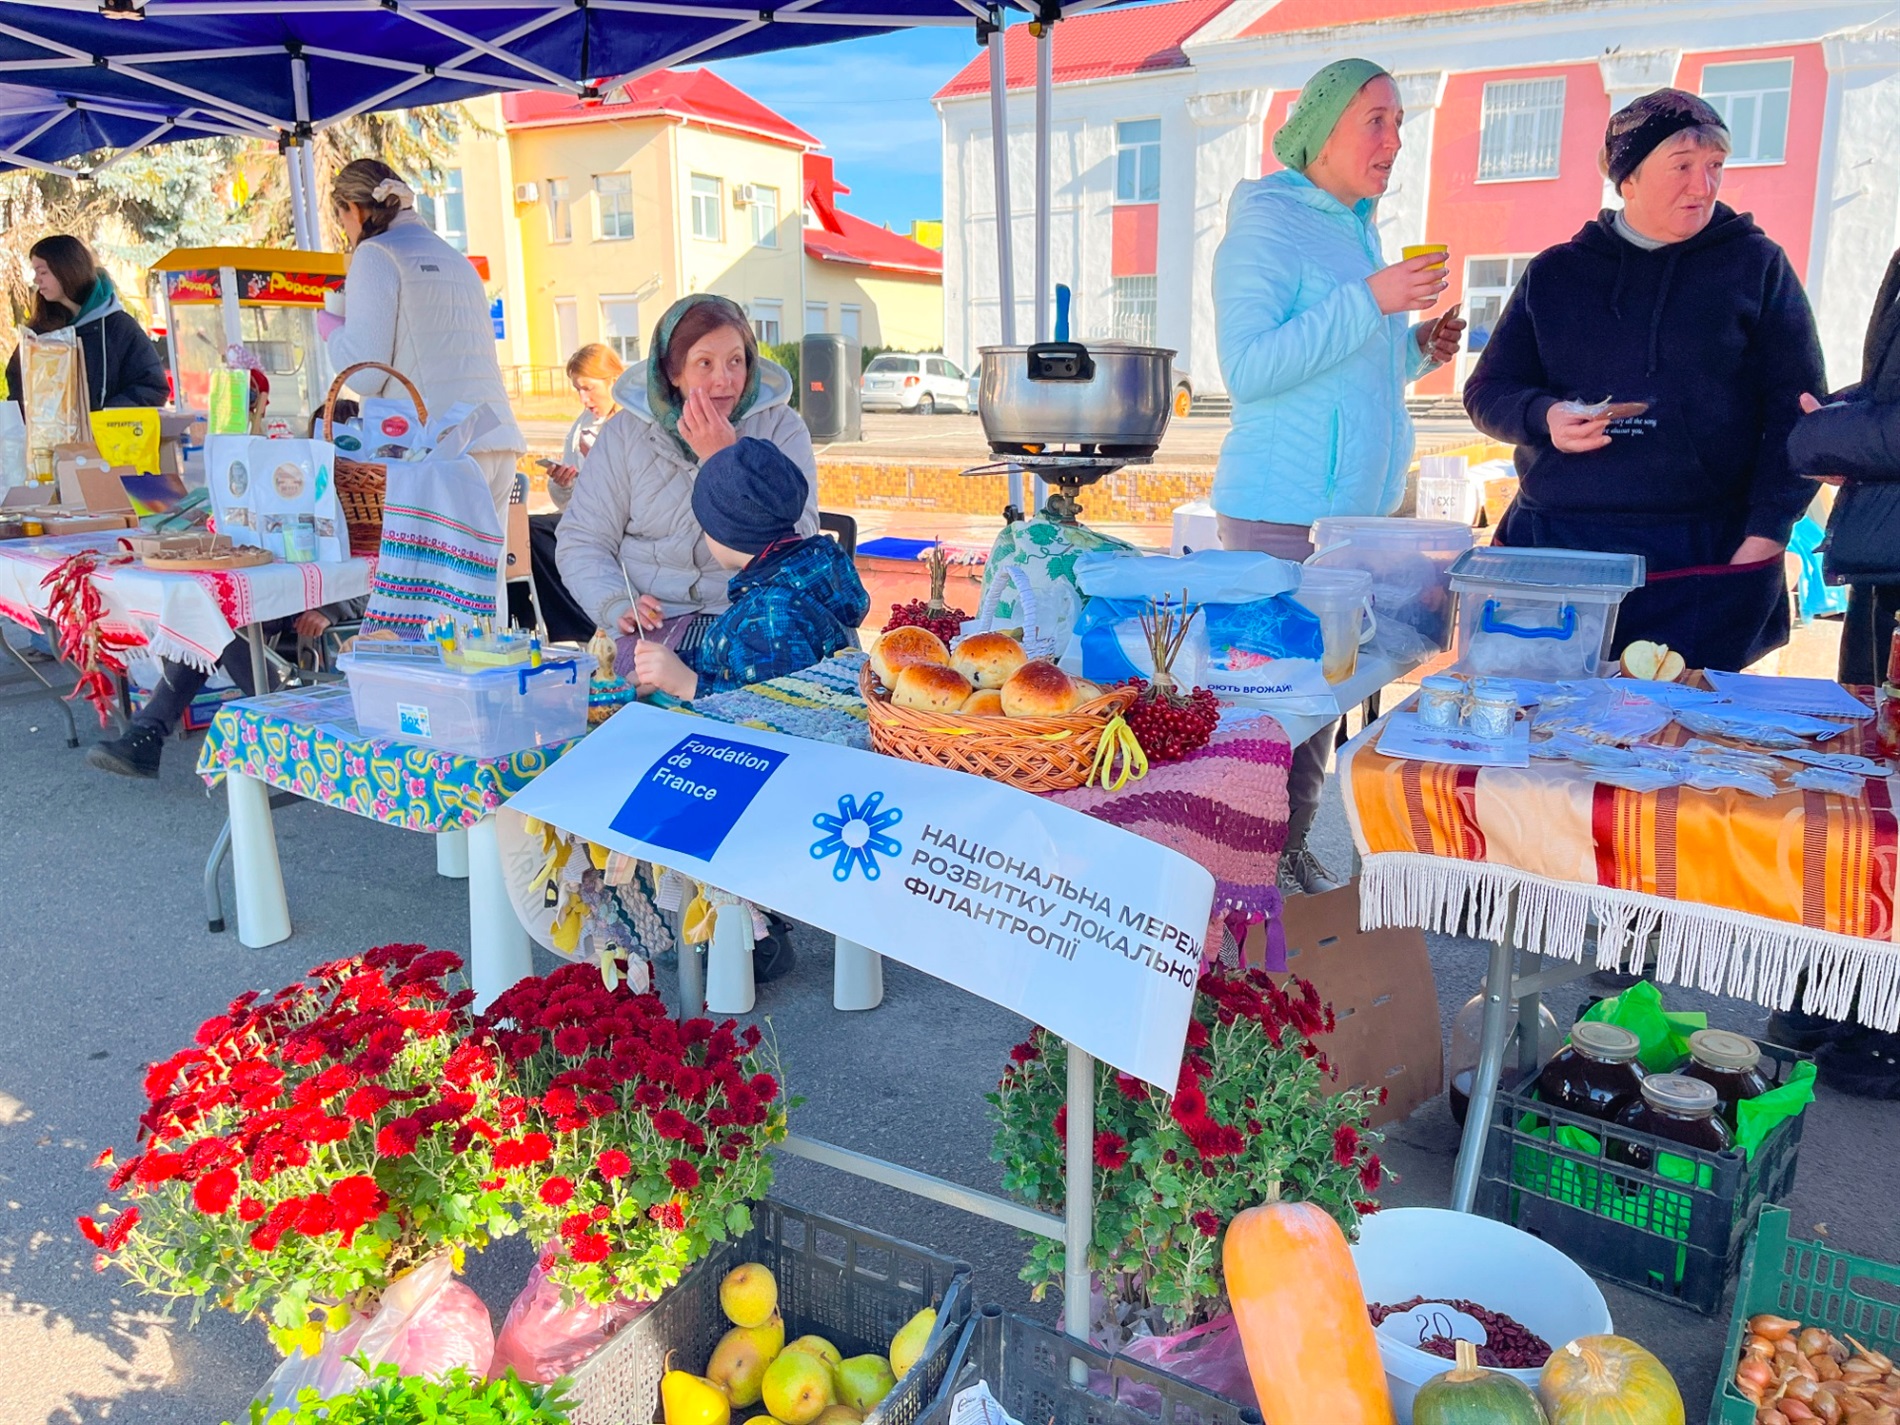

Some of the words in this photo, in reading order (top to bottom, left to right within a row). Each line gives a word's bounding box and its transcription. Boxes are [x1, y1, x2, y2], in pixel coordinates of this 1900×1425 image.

[178, 273, 212, 297] Popcorn
[1207, 684, 1240, 692] ОЮТЬ
[1243, 684, 1293, 694] ВРОЖАЙ!
[667, 753, 692, 769] de
[681, 740, 770, 771] Fondation
[652, 767, 717, 801] France
[911, 849, 1056, 918] РОЗВИТКУ
[921, 824, 1111, 918] НАЦІОНАЛЬНА
[1118, 905, 1202, 964] МЕРЕЖ
[904, 875, 1081, 961] ФІЛАНТРОПІЇ
[1415, 1311, 1453, 1342] 20
